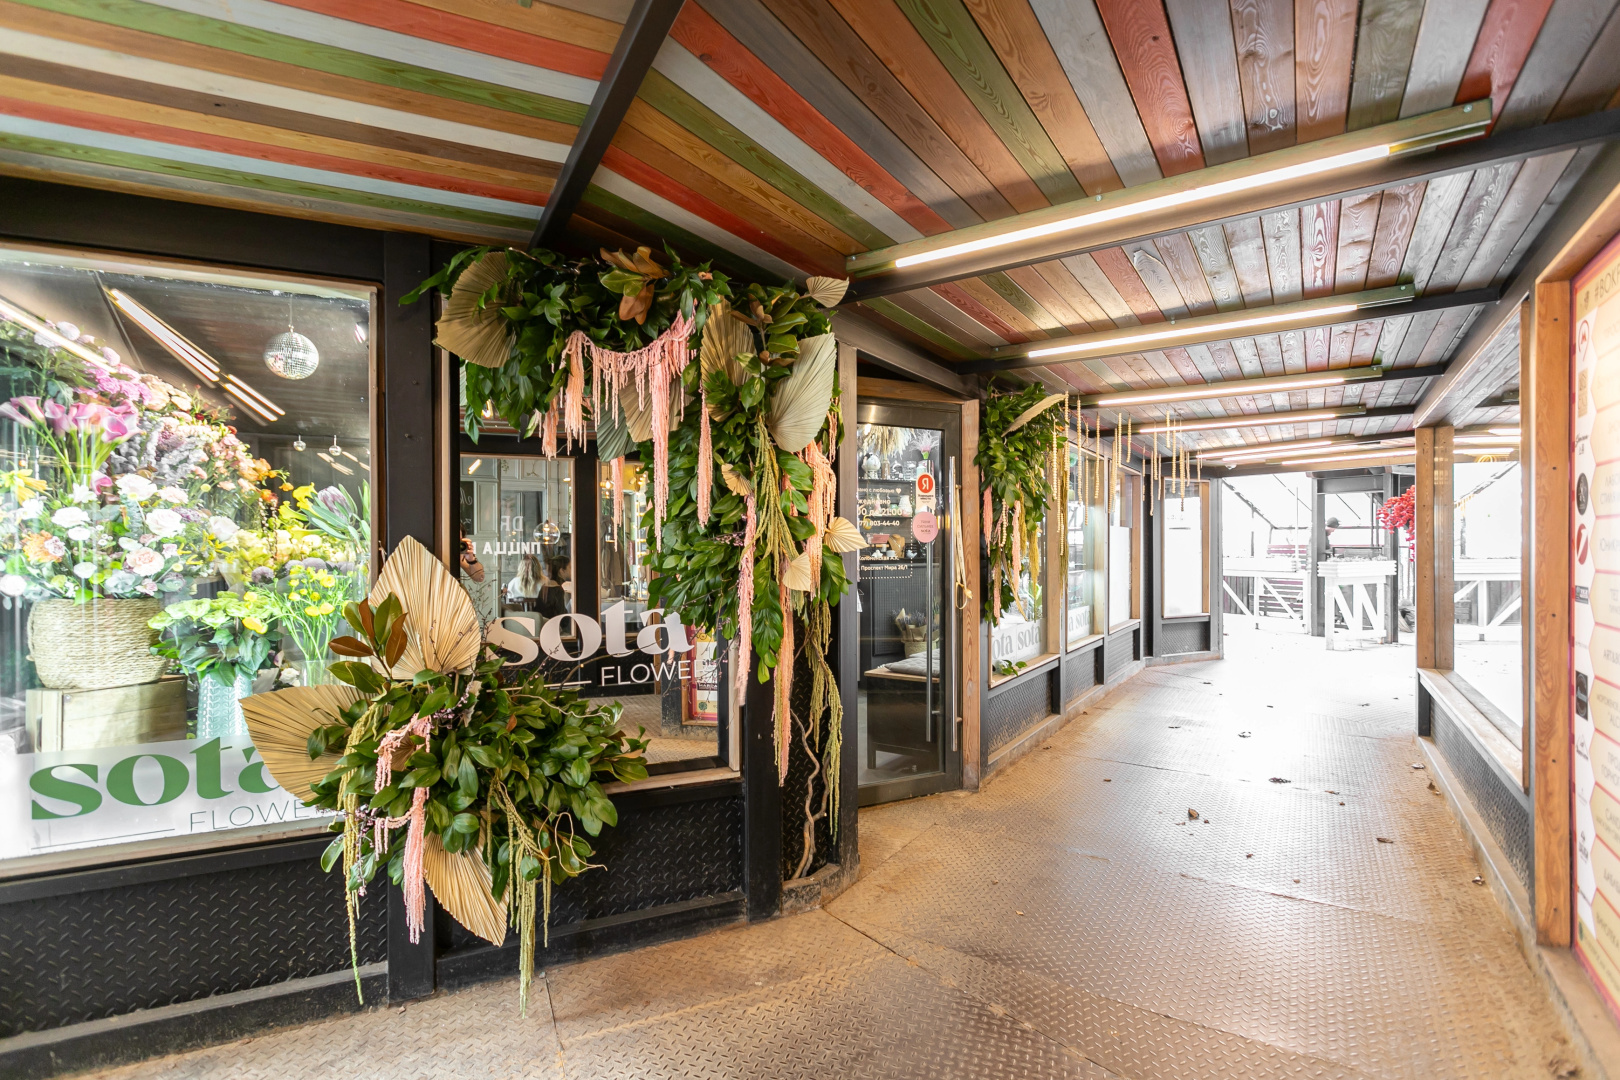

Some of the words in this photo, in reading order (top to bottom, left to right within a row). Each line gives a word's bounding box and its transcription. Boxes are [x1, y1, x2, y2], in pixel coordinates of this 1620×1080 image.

[921, 477, 929, 490] Я
[881, 508, 903, 516] 21:00
[1075, 609, 1091, 627] sota
[484, 600, 695, 667] sota
[991, 633, 1014, 660] ota
[1017, 624, 1042, 651] sota
[190, 799, 311, 833] FLOWE
